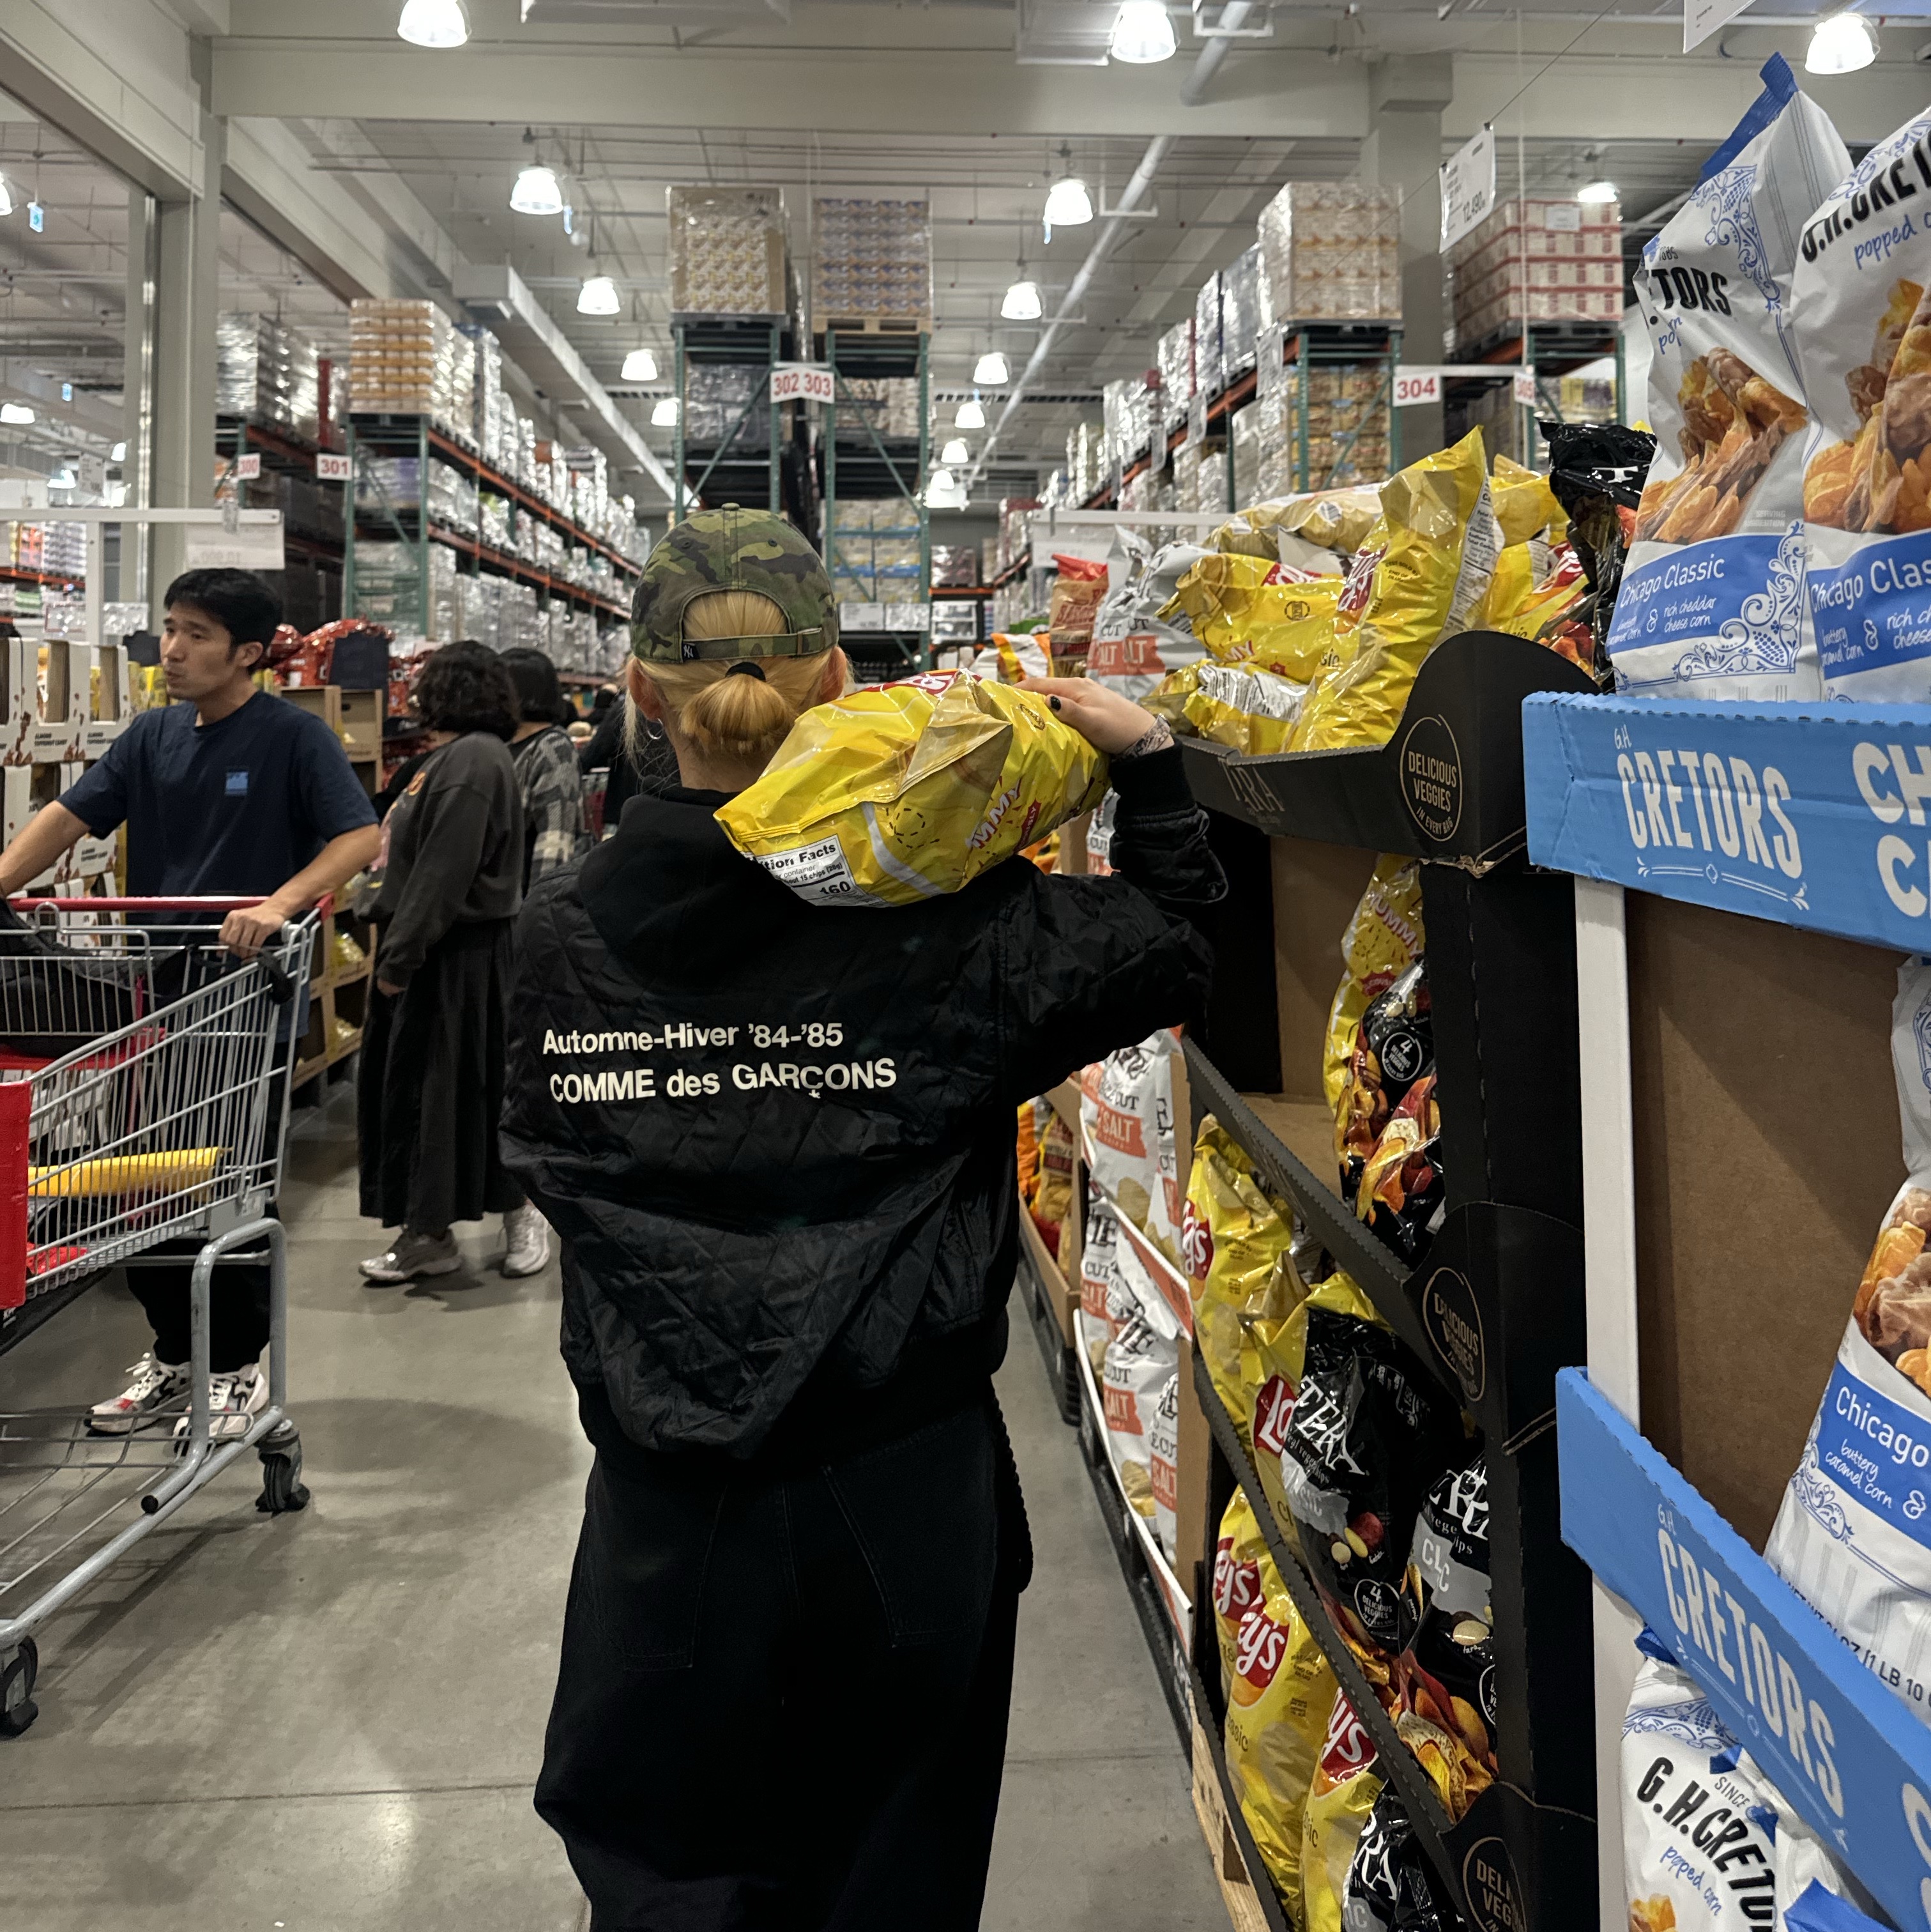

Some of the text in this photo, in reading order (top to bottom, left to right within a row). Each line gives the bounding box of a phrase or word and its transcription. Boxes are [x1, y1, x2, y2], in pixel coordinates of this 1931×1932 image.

[1854, 214, 1918, 270] popped
[1647, 266, 1732, 316] TORS
[774, 372, 798, 396] 302
[804, 372, 831, 396] 303
[1396, 377, 1436, 401] 304
[321, 458, 349, 475] 301
[1620, 553, 1725, 608] Chicago Classic
[1810, 574, 1864, 613] Chicago
[1101, 624, 1122, 637] CUT
[1690, 614, 1711, 627] corn
[1863, 619, 1881, 650] &
[1886, 608, 1913, 630] rich
[1408, 751, 1457, 788] DELICIOUS
[1413, 778, 1451, 813] VEGGIES
[1416, 806, 1454, 835] IN EVERY BAG
[1617, 749, 1803, 879] CRETORS
[760, 843, 836, 871] tion Facts
[784, 865, 816, 878] container
[800, 873, 809, 882] 15
[809, 869, 826, 881] chips
[827, 862, 843, 875] (28g)
[820, 880, 851, 895] 160
[542, 1022, 844, 1055] Automne-Hiver '84-'85
[1400, 1039, 1413, 1054] 4
[549, 1057, 897, 1104] COMME des GARÇONS
[1103, 1112, 1134, 1142] SALT
[1836, 1386, 1929, 1468] Chicago
[1841, 1438, 1879, 1483] buttery
[1825, 1451, 1893, 1509] caramel corn
[1902, 1489, 1927, 1520] &
[1421, 1538, 1451, 1593] CLC
[1362, 1595, 1393, 1613] DELICIOUS
[1370, 1585, 1382, 1602] 4
[1364, 1604, 1389, 1620] VEGGIES
[1658, 1528, 1844, 1820] CRETORS
[1879, 1660, 1901, 1687] LB
[1905, 1678, 1924, 1701] 10
[1714, 1775, 1751, 1808] SINCE
[1482, 1887, 1513, 1927] VEG
